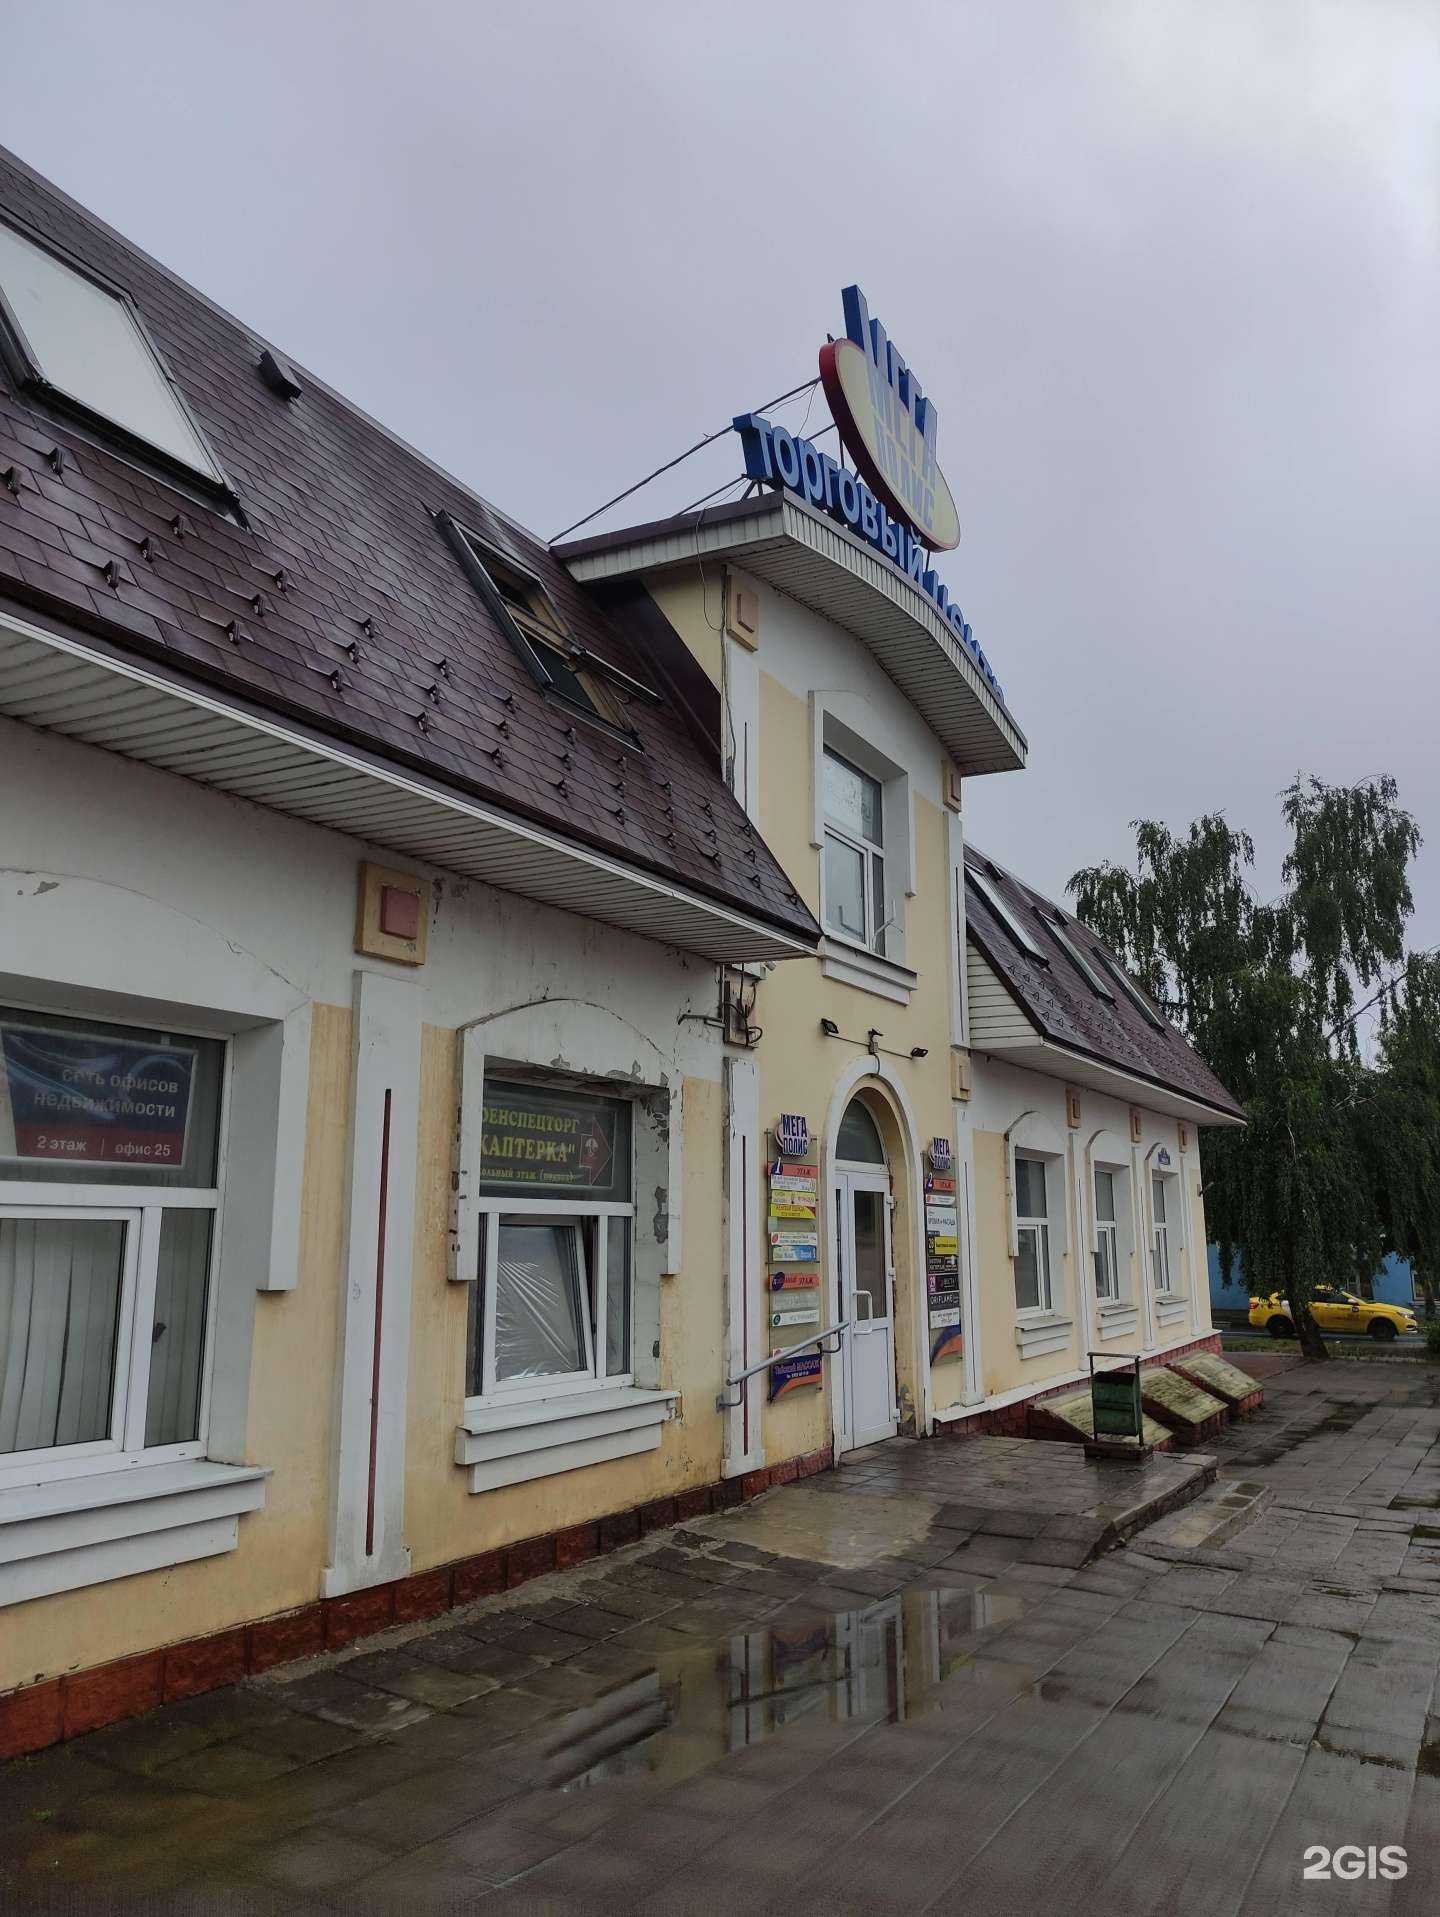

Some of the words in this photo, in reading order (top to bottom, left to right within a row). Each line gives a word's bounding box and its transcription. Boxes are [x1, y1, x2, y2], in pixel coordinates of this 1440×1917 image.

[110, 1073, 178, 1093] офисов
[34, 1093, 175, 1118] недвижимости
[781, 1114, 808, 1138] МЕГА
[37, 1135, 47, 1149] 2
[50, 1139, 87, 1151] этаж
[115, 1143, 151, 1156] офис
[154, 1143, 171, 1156] 25
[783, 1137, 808, 1156] ПОЛИС
[932, 1136, 950, 1156] МЕГА
